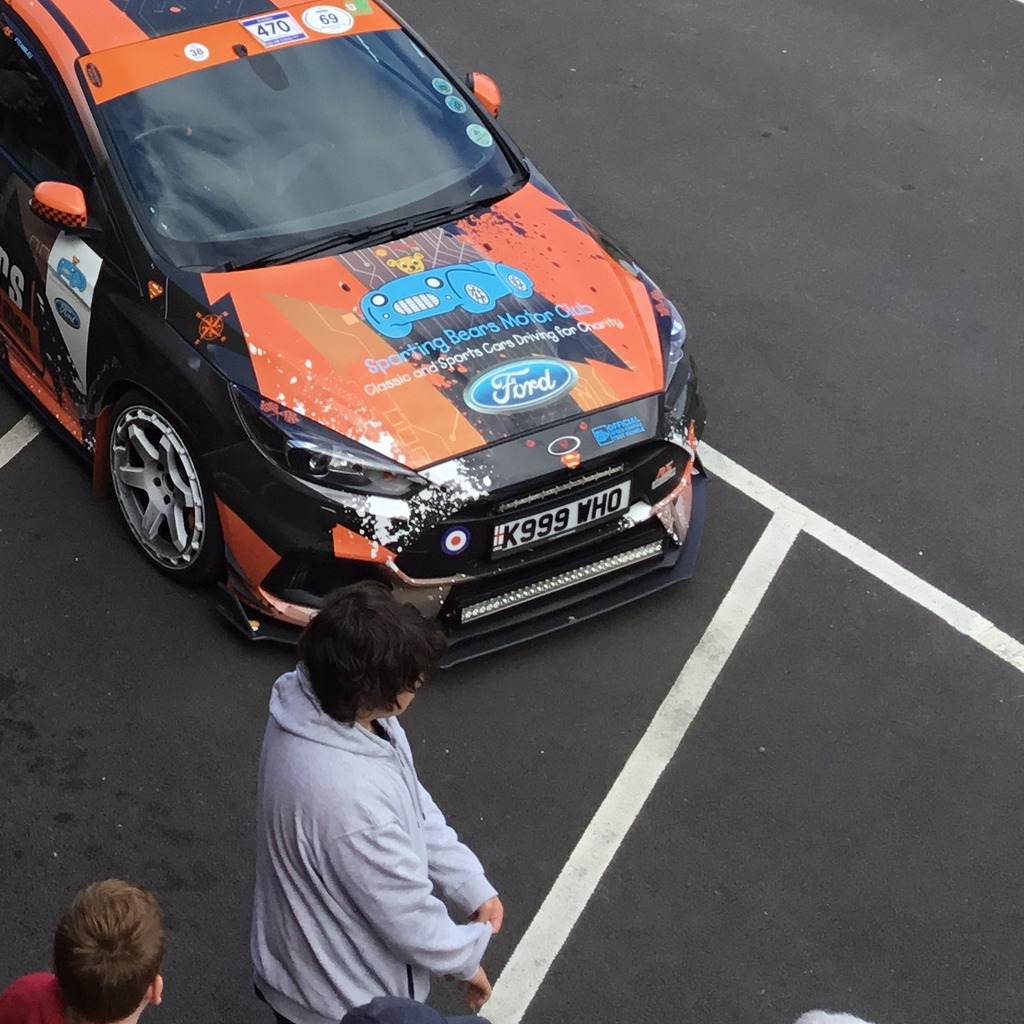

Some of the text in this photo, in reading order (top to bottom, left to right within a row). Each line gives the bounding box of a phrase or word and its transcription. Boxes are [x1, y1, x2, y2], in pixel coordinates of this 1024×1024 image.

[257, 20, 291, 37] 470
[319, 13, 339, 25] 69
[189, 48, 204, 57] 38
[364, 300, 595, 375] Sporting Bears Motor Club
[363, 315, 625, 397] Classic and Sports Cars Driving for Charity
[490, 366, 557, 404] Ford
[607, 416, 641, 431] OFFICIAL
[501, 487, 623, 548] K999 WHO
